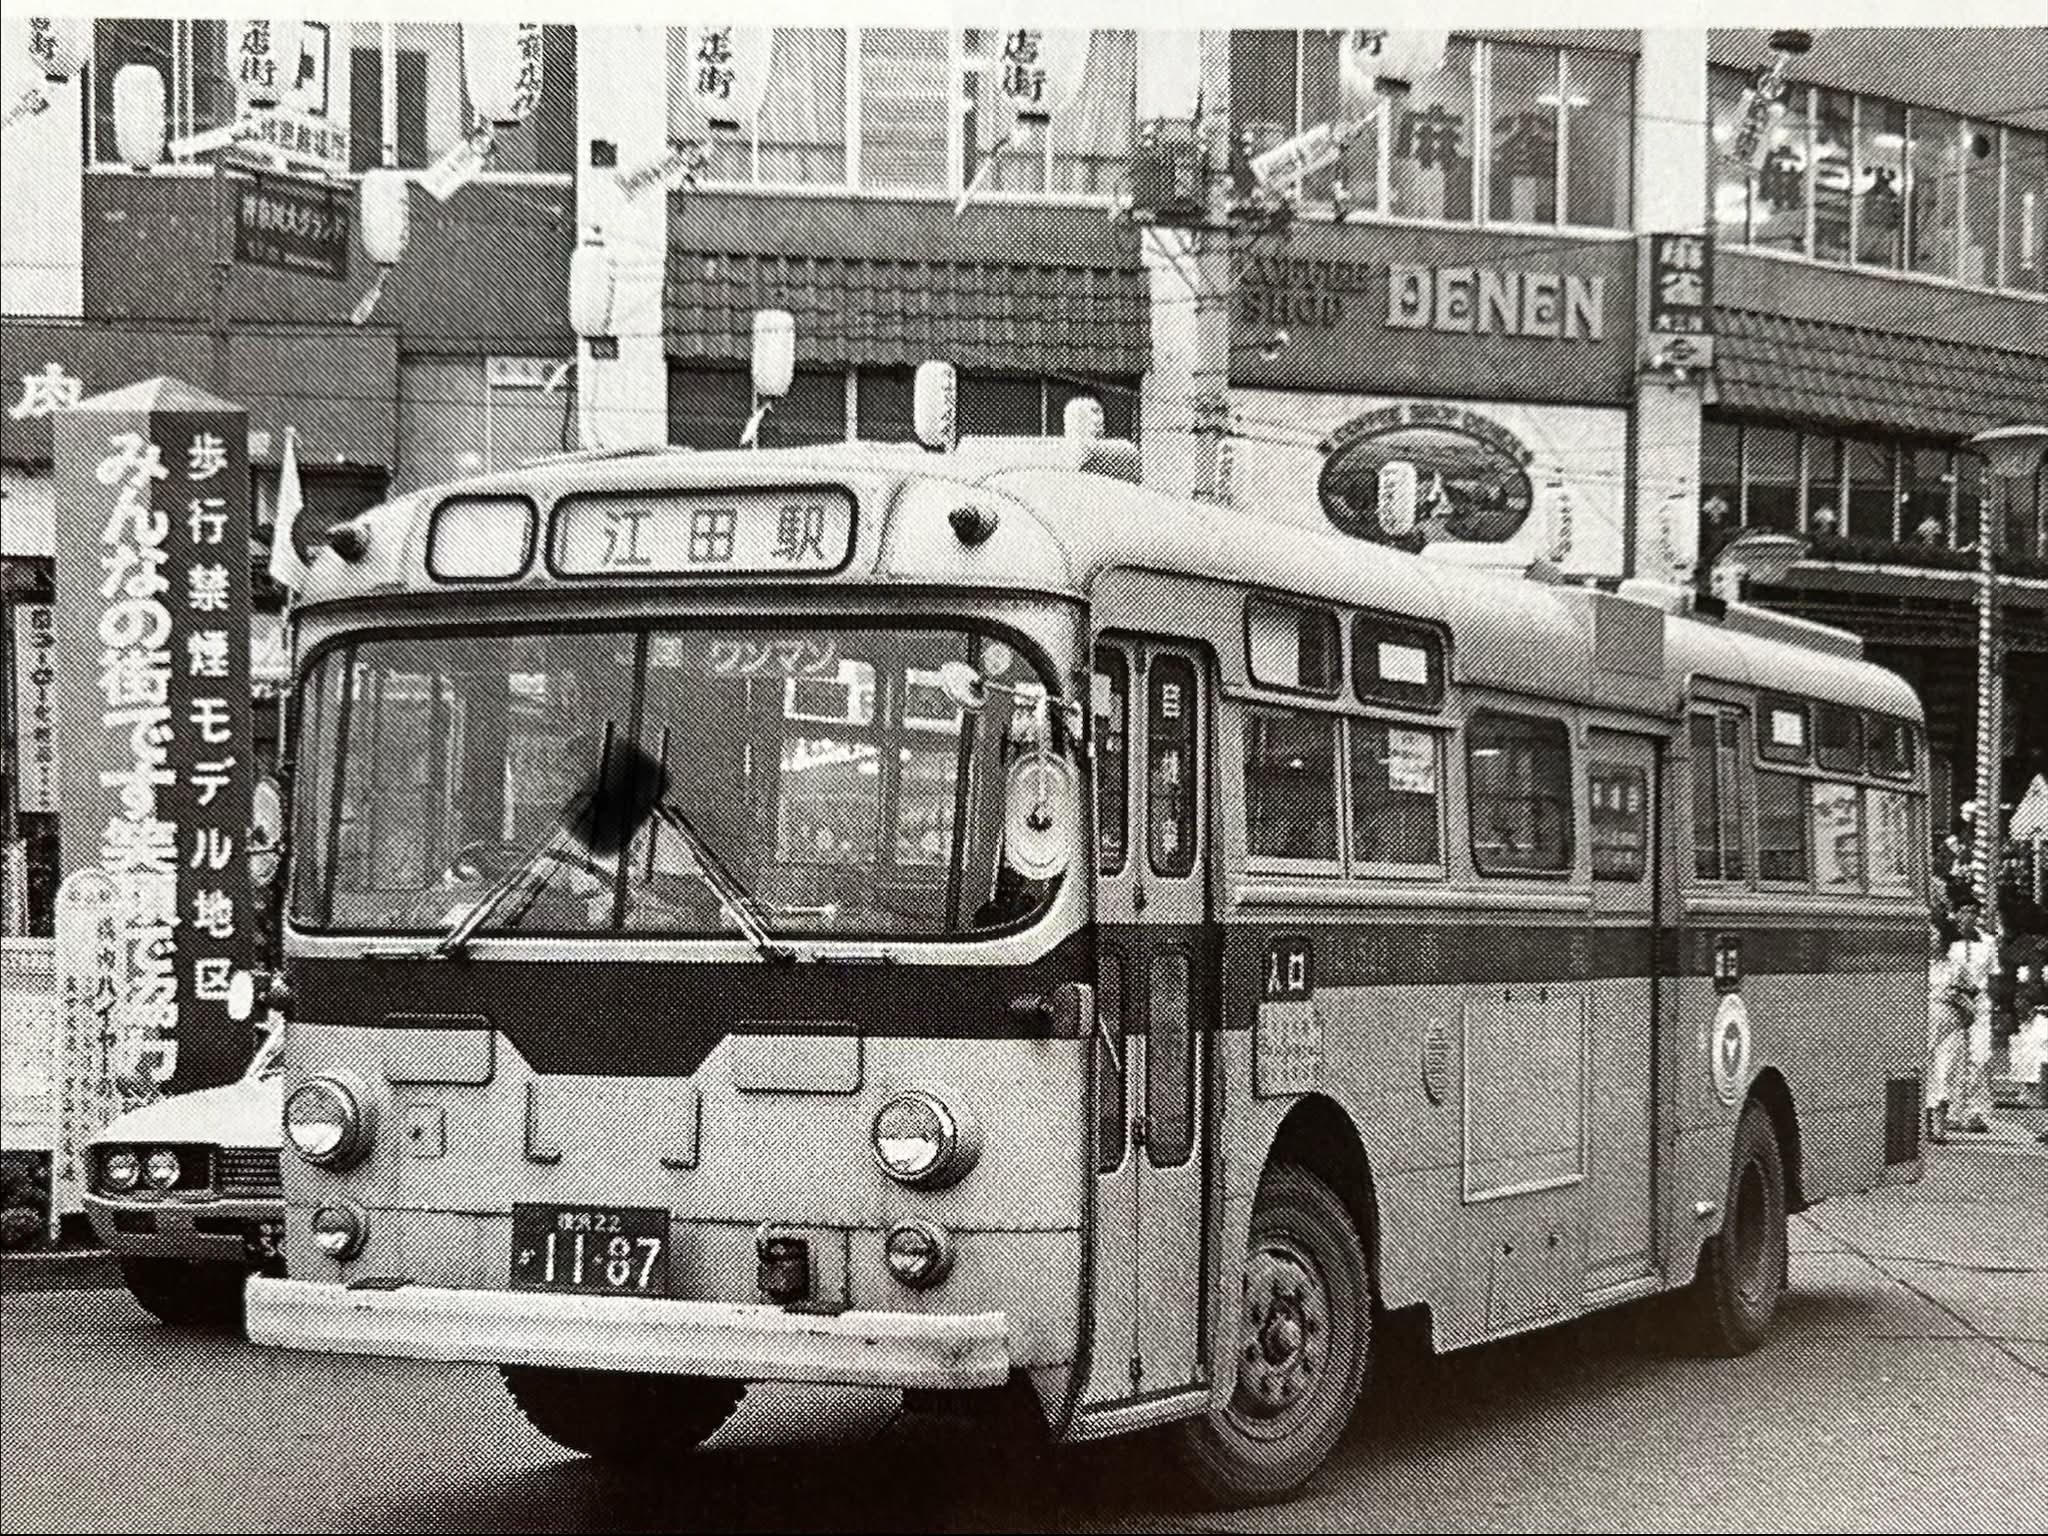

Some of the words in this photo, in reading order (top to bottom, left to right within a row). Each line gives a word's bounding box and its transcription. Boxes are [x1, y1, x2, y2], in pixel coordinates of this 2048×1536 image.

[1385, 263, 1604, 340] DENEN
[1660, 237, 1704, 306] 麻雀
[1241, 291, 1345, 329] SHOP
[605, 506, 826, 567] 江田駅
[710, 639, 836, 674] ワンマン
[187, 431, 236, 1000] 歩行禁煙モデル地区
[1267, 951, 1305, 992] 入口
